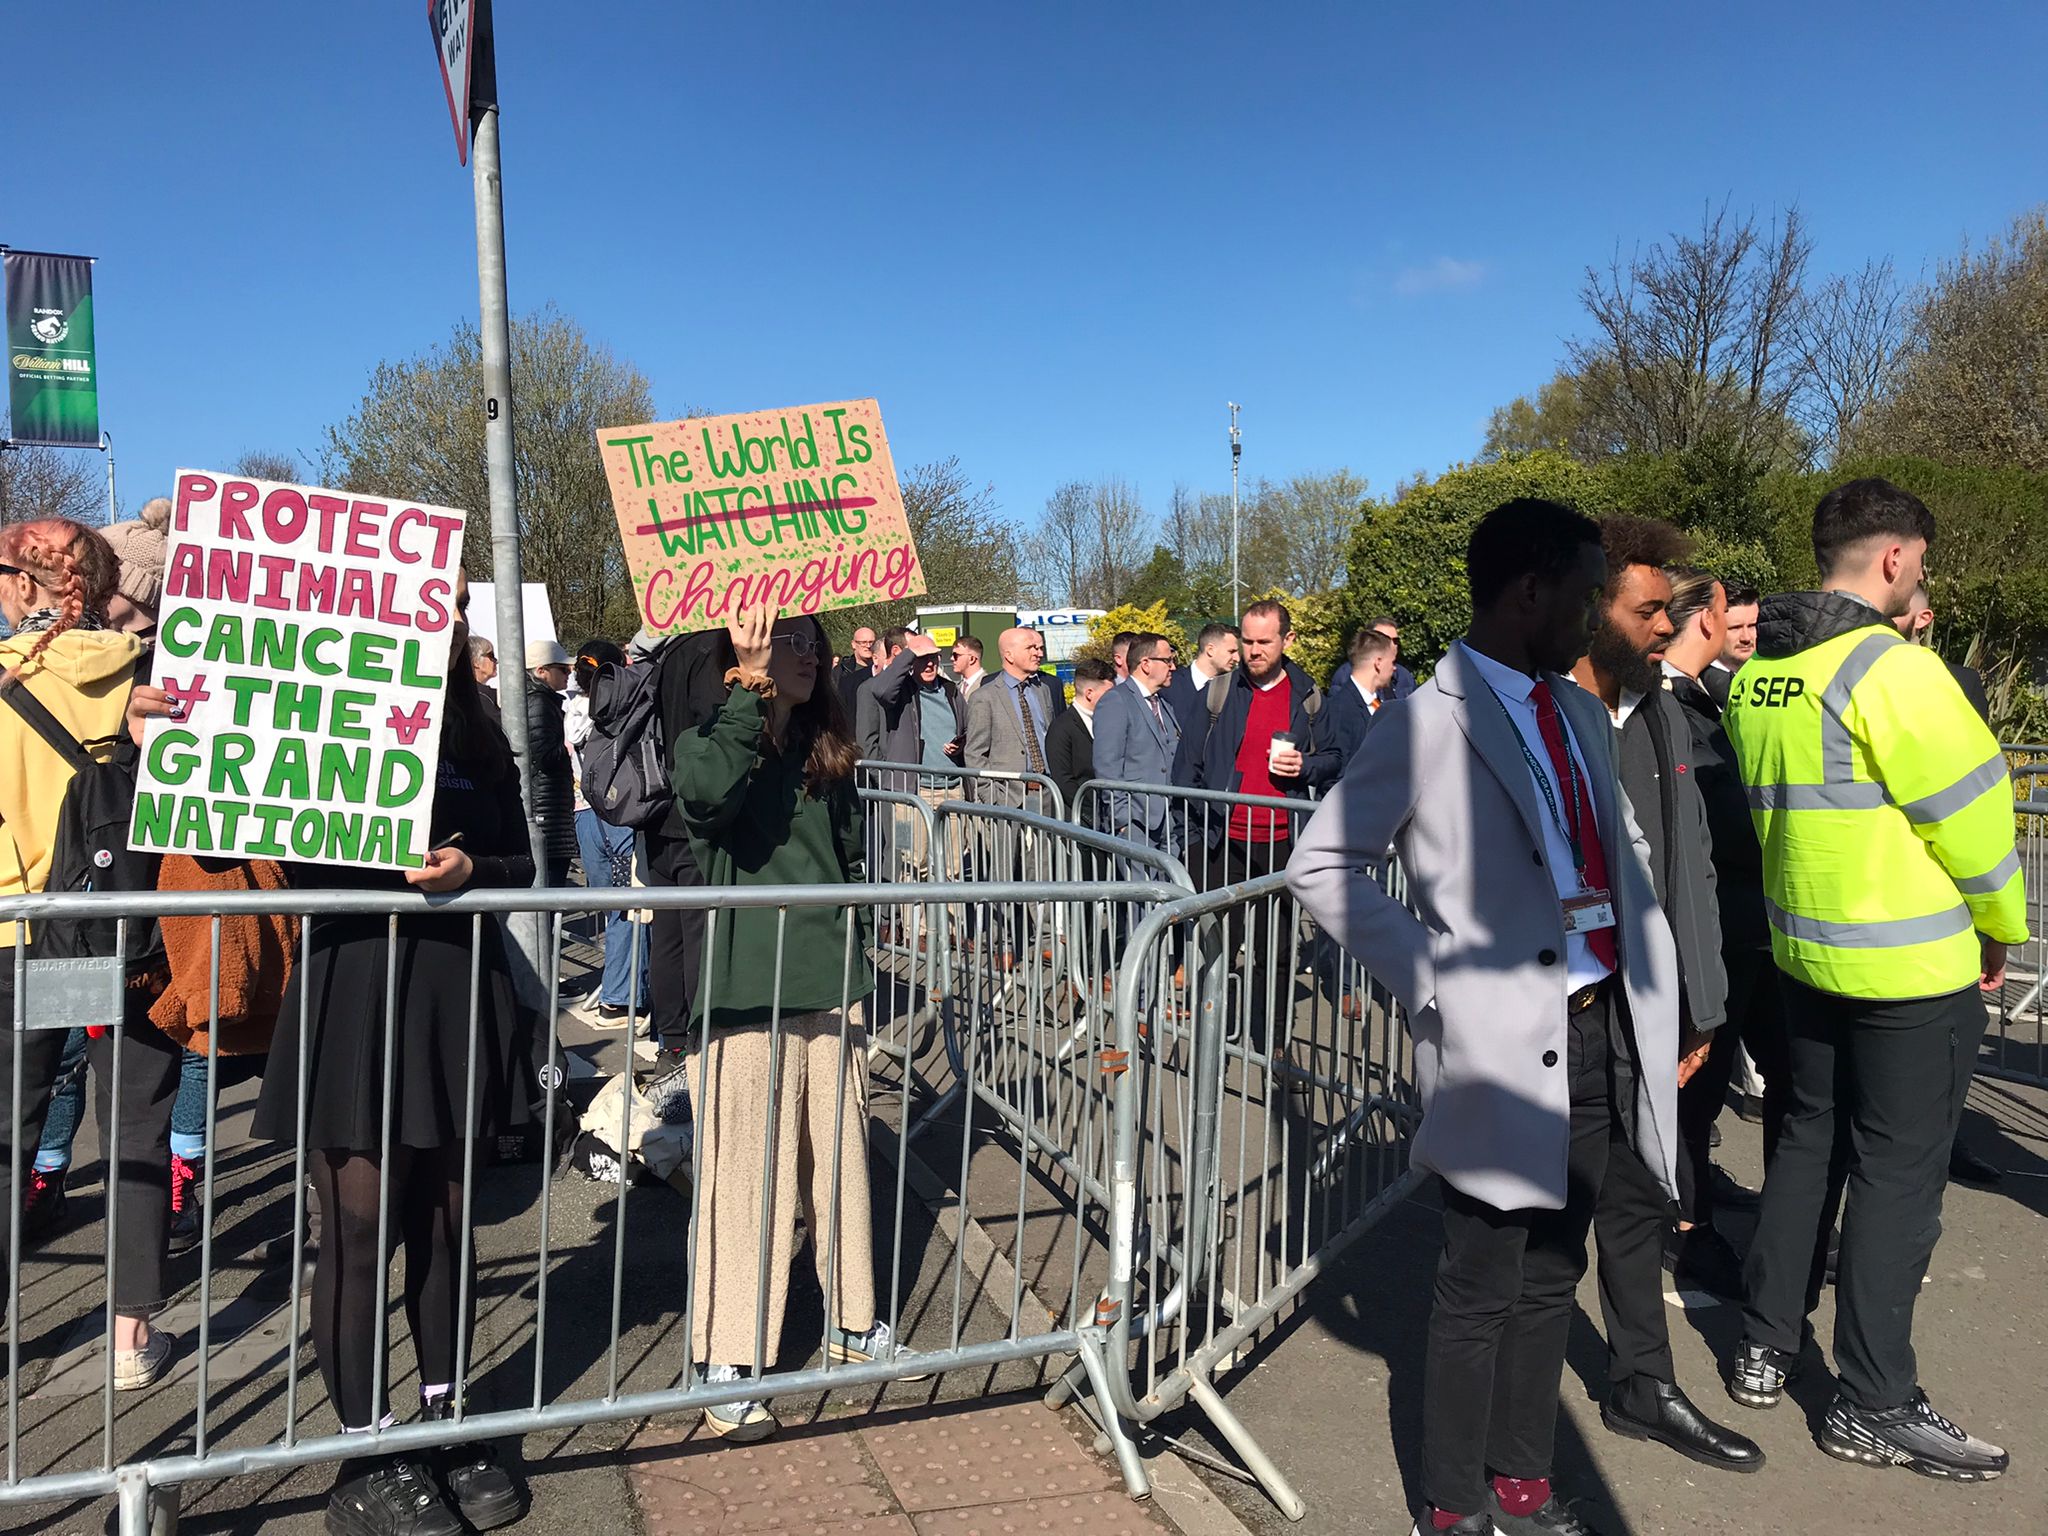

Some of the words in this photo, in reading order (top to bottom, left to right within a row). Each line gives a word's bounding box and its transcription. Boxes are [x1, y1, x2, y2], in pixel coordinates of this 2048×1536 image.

[447, 18, 465, 67] WAY
[12, 354, 62, 370] William
[63, 358, 91, 372] HILL
[487, 398, 498, 420] 9
[607, 436, 693, 488] The
[702, 413, 820, 479] World
[823, 408, 873, 465] Is
[175, 474, 463, 570] PROTECT
[647, 473, 868, 558] WATCHING
[166, 543, 450, 633] ANIMALS
[645, 543, 916, 630] Changing
[161, 607, 443, 689] CANCEL
[225, 676, 376, 740] THE
[1750, 676, 1805, 708] SEP
[147, 729, 424, 808] GRAND
[1522, 746, 1543, 778] RANDOX
[1540, 777, 1555, 806] GRAND
[132, 792, 424, 868] NATIONAL
[31, 960, 111, 973] SMARTWELD
